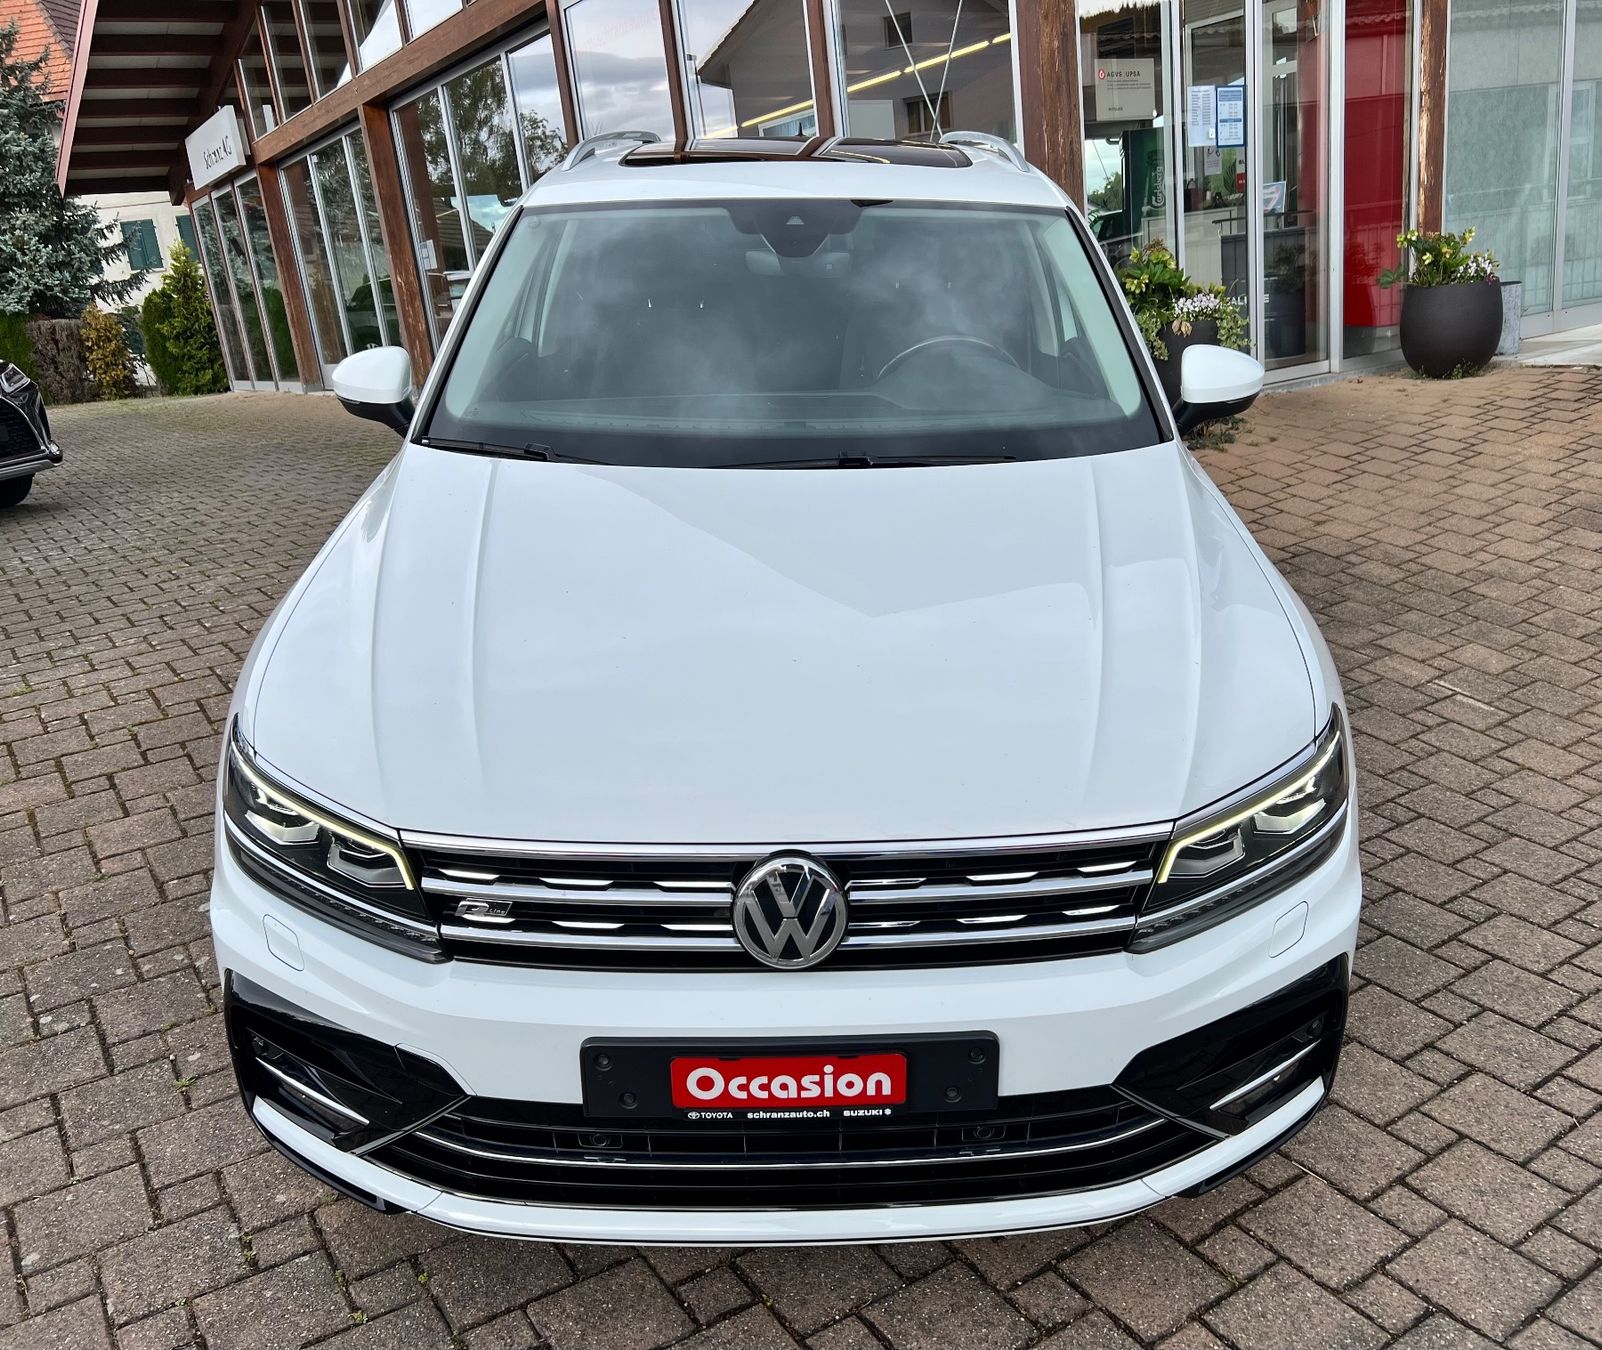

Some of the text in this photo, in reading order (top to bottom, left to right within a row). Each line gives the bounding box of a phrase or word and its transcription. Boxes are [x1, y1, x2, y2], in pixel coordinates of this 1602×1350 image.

[1125, 70, 1141, 78] UPSA
[1151, 165, 1166, 208] Carlsberg
[686, 1064, 892, 1100] Occasion
[700, 1111, 734, 1120] TOYOTA
[746, 1109, 831, 1120] schranzauto.ch
[842, 1109, 883, 1117] SUZUKI
